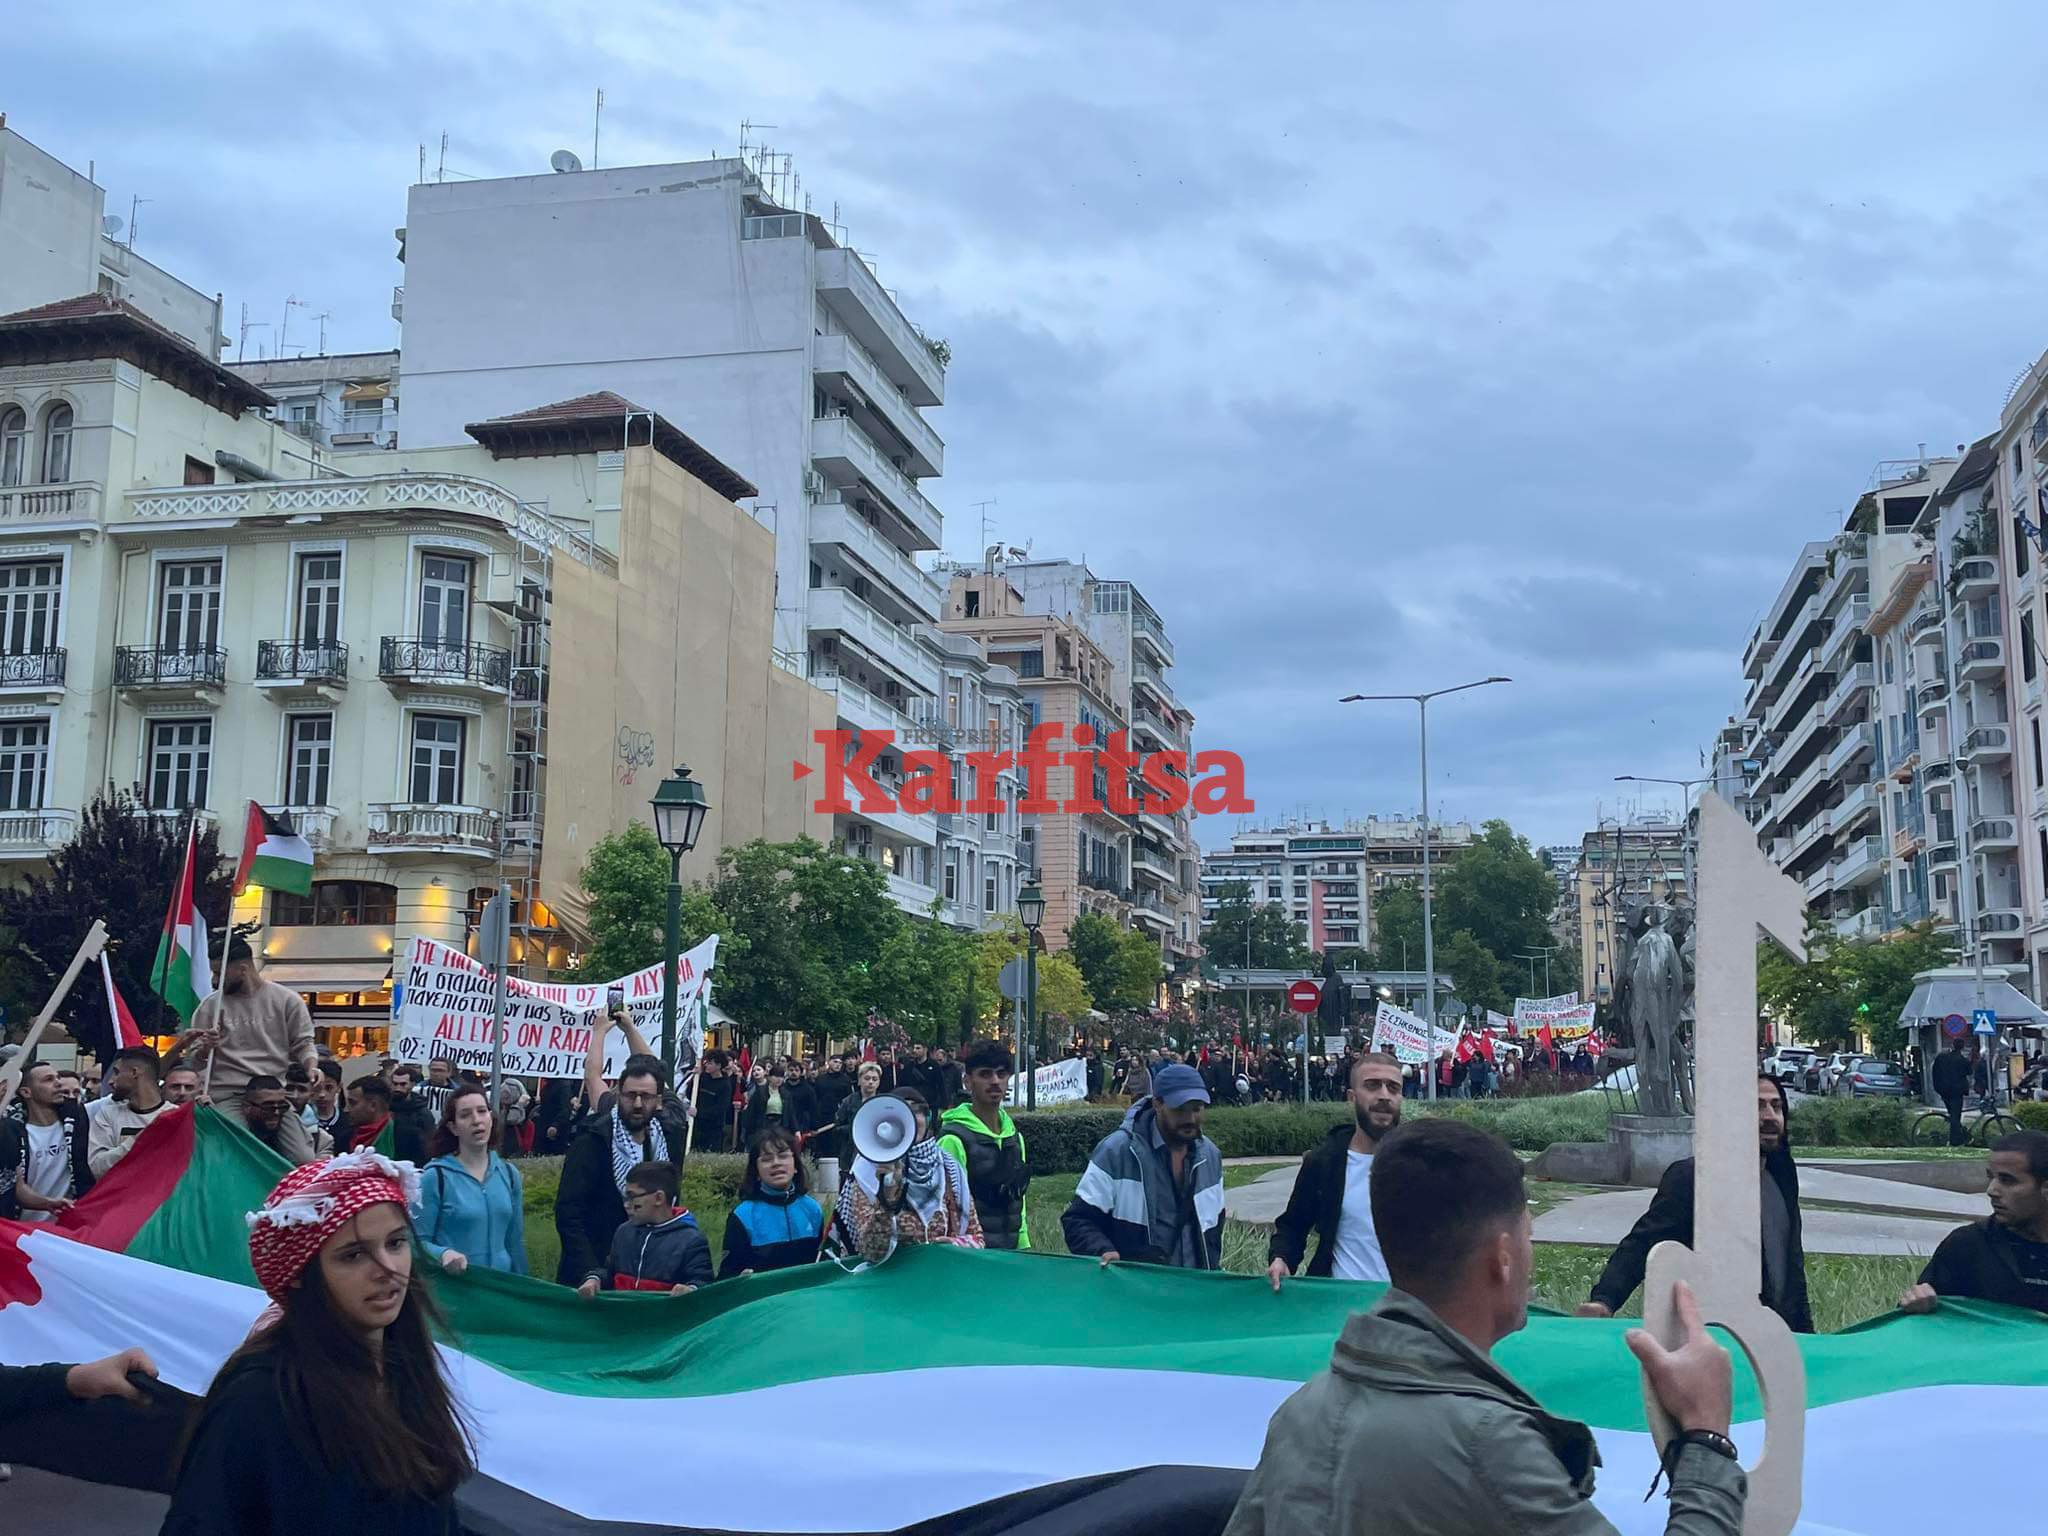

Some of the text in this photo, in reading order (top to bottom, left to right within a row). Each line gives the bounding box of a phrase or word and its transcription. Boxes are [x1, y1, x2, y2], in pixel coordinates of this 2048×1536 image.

[408, 965, 429, 989] Να
[523, 1003, 553, 1022] μας
[434, 1012, 467, 1042] ALL
[516, 1022, 544, 1049] ON
